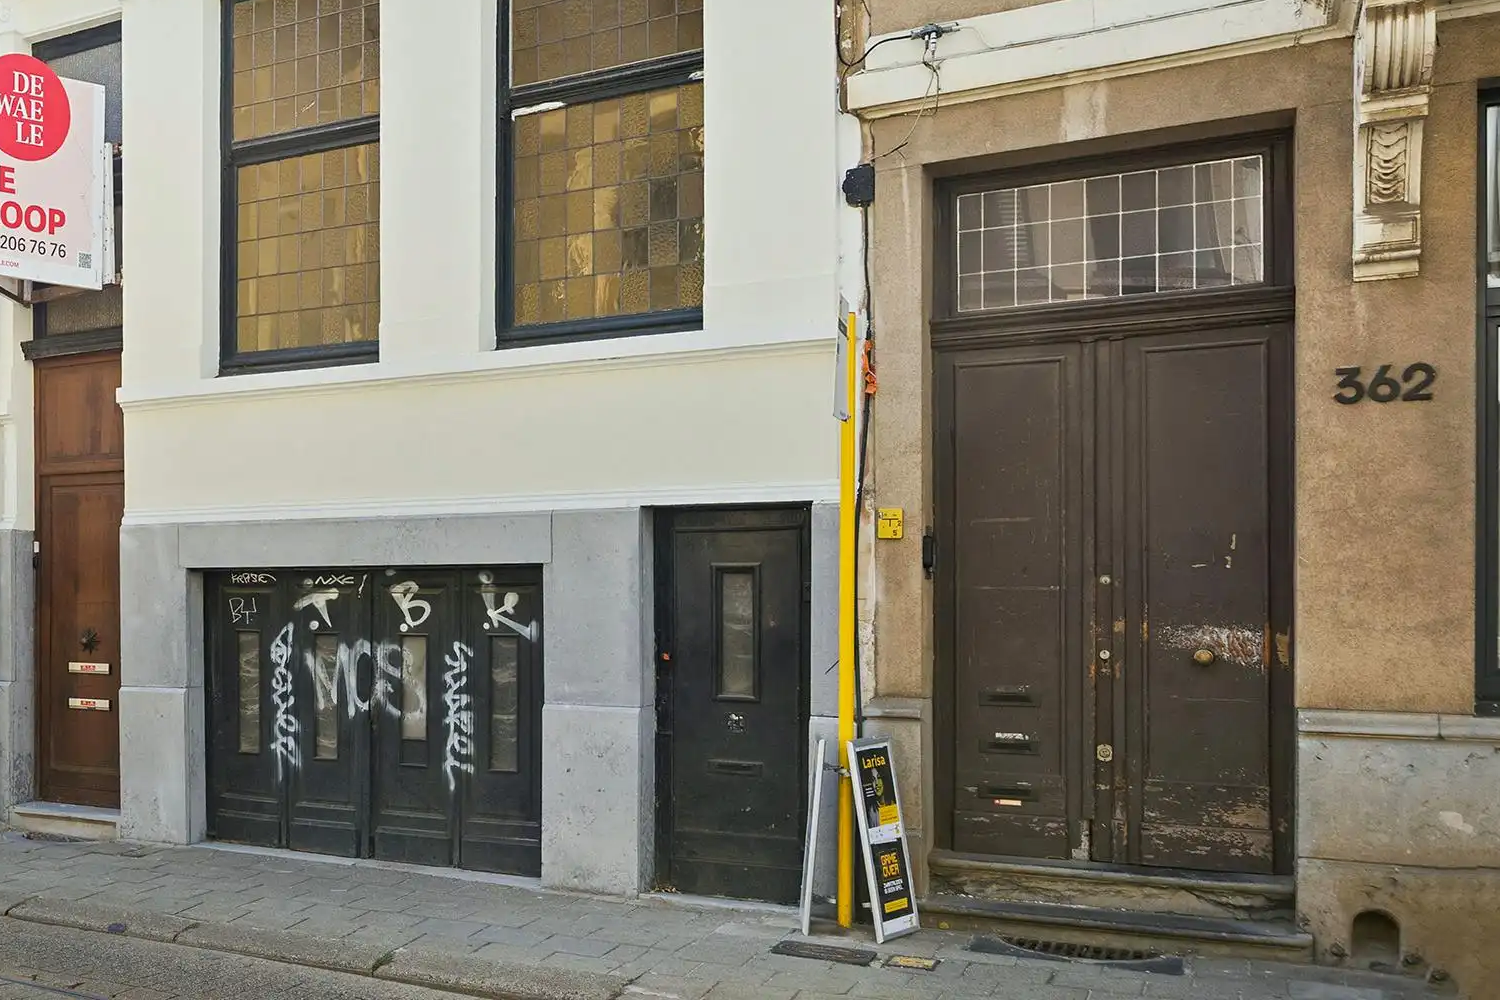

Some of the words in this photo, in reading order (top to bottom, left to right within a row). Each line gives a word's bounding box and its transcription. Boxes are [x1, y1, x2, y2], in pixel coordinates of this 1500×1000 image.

[12, 70, 44, 98] DE
[15, 120, 44, 147] LE
[0, 234, 26, 252] 206
[29, 239, 46, 256] 76
[50, 242, 67, 258] 76
[1332, 362, 1437, 405] 362
[862, 754, 886, 769] Larisa
[882, 863, 900, 877] OVER
